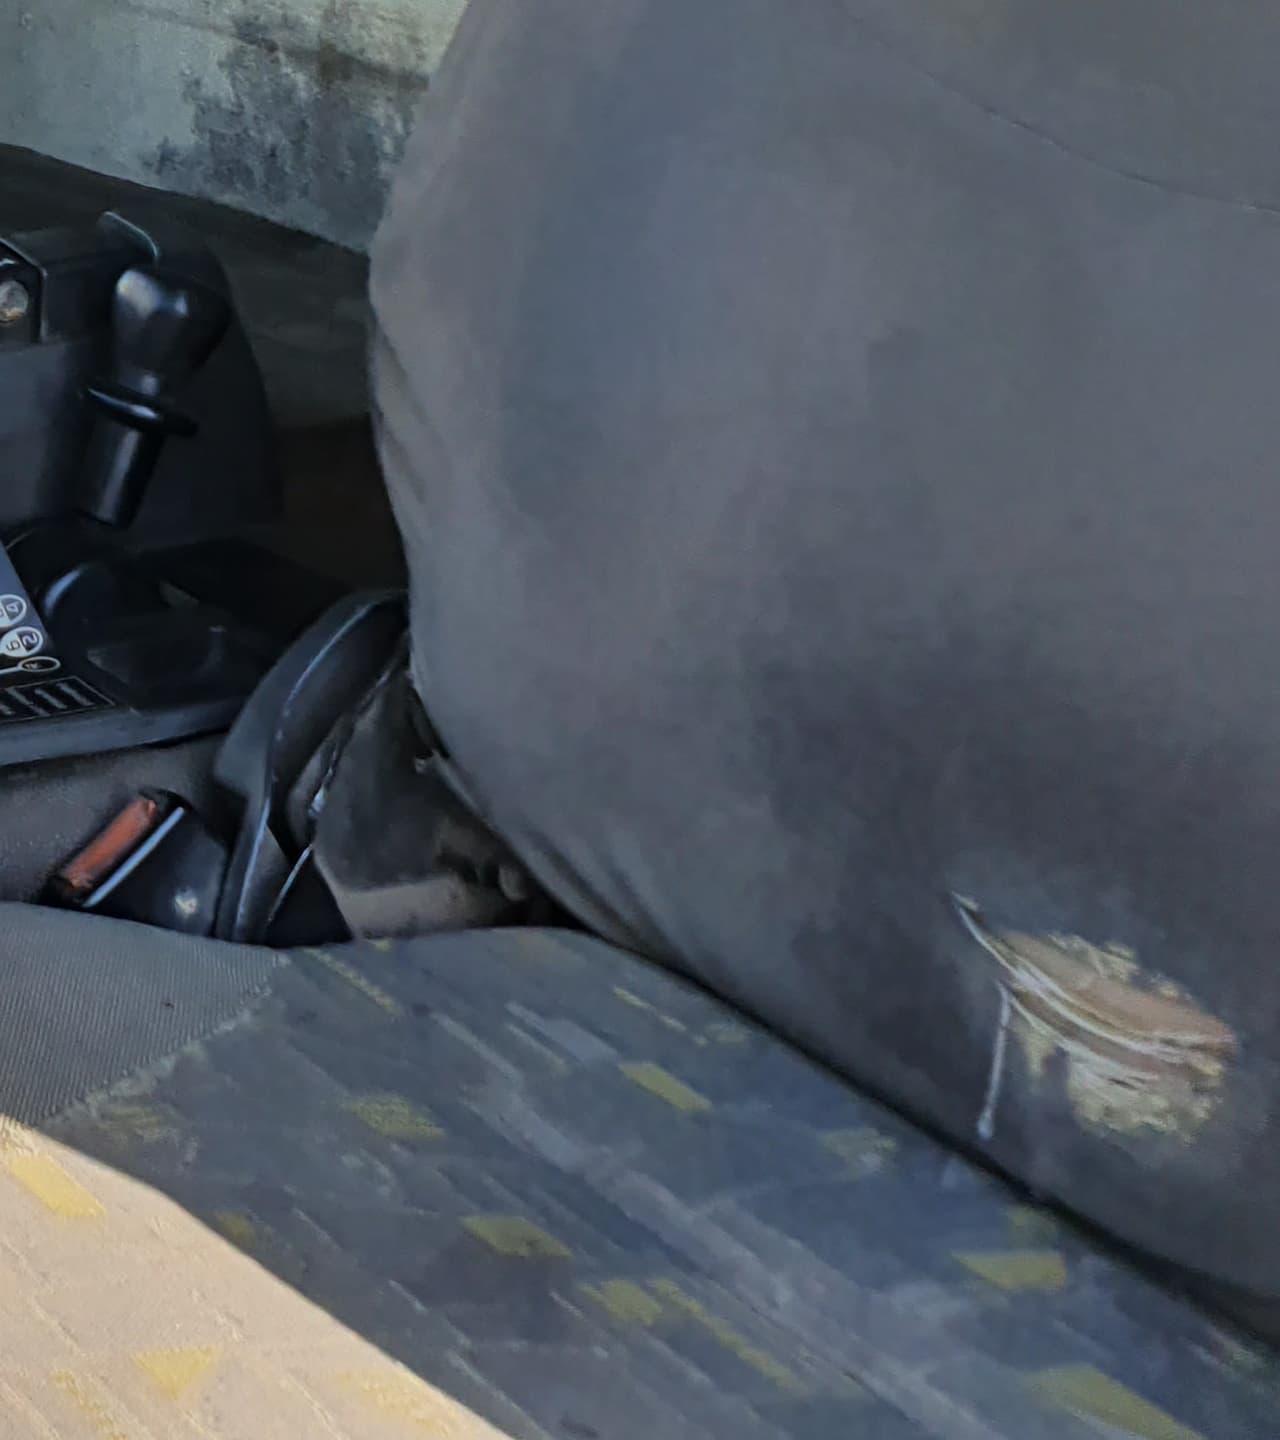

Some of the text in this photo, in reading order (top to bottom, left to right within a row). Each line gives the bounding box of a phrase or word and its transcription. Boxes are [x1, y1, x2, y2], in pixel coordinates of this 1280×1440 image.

[6, 601, 20, 614] 4
[22, 632, 38, 647] 2
[6, 641, 20, 652] 6
